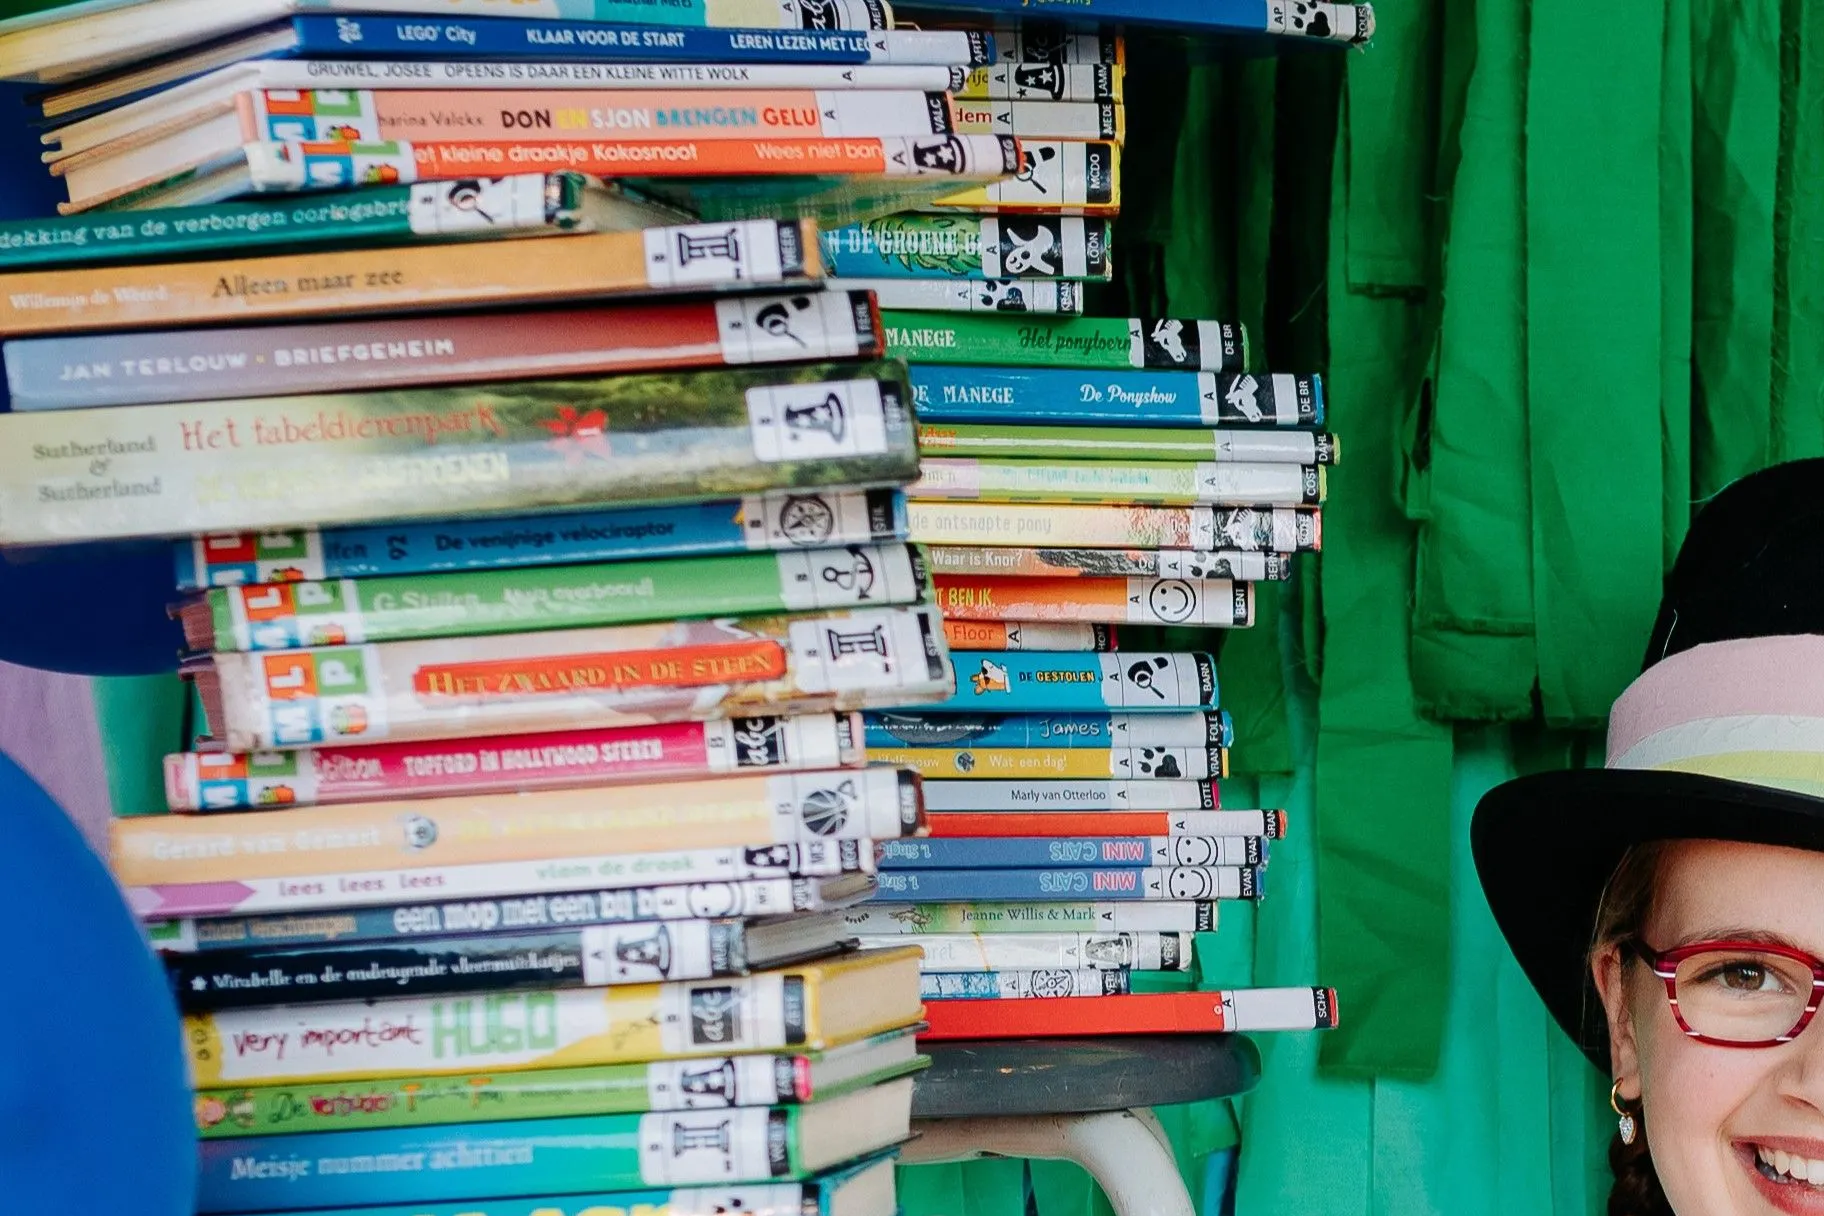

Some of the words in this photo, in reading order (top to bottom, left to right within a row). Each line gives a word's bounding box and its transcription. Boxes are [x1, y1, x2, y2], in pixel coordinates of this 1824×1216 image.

[445, 26, 476, 45] City
[526, 27, 574, 45] KLAAR
[578, 28, 618, 46] VOOR
[621, 30, 641, 46] DE
[643, 31, 685, 47] START
[729, 34, 773, 49] LEREN
[776, 35, 817, 51] LEZEN
[819, 36, 846, 51] MET
[382, 62, 432, 79] JOSEE
[444, 65, 505, 80] OPEENS
[526, 66, 569, 81] DAAR
[573, 66, 601, 81] EEN
[605, 65, 656, 81] KLEINE
[659, 66, 704, 82] WITTE
[500, 110, 552, 129] DON
[591, 108, 650, 129] SJON
[656, 108, 758, 128] BRENGEN
[1100, 104, 1113, 135] MEDE
[440, 143, 504, 164] kleine
[508, 143, 589, 167] draakje
[593, 141, 698, 163] Kokosnoot
[1088, 153, 1101, 190] MCDO
[140, 218, 168, 238] de
[173, 210, 288, 236] verborgen
[884, 329, 957, 349] MANEGE
[1017, 324, 1053, 351] Het
[59, 359, 111, 381] JAN
[119, 352, 248, 378] TERLOUW
[273, 339, 455, 369] BRIEFGEHEIM
[943, 386, 1015, 404] MANEGE
[1079, 383, 1102, 402] De
[1108, 384, 1177, 407] Ponyshow
[31, 434, 157, 462] Sutherland
[178, 418, 241, 453] Het
[1318, 433, 1328, 463] DAHL
[36, 476, 163, 503] Sutherland
[1306, 467, 1317, 497] COST
[435, 533, 464, 553] De
[560, 520, 676, 544] velociraptor
[934, 514, 1011, 534] ontsnapte
[1016, 516, 1052, 536] pony
[931, 548, 966, 567] Waar
[968, 550, 983, 567] is
[985, 551, 1024, 569] Knor?
[948, 588, 974, 608] BEN
[1235, 587, 1246, 618] BENT
[953, 623, 995, 641] Floor
[1035, 670, 1095, 684] GESTOLEN
[1202, 662, 1213, 694] BARN
[1039, 719, 1100, 738] James
[501, 744, 599, 772] HOLLYWOOD
[988, 754, 1015, 769] Wat
[1017, 756, 1041, 769] een
[1043, 753, 1069, 772] dag!
[1010, 788, 1041, 803] Marly
[1042, 790, 1061, 801] van
[1062, 788, 1107, 801] Otterloo
[1049, 842, 1098, 862] CATS
[1101, 842, 1146, 861] MINI
[1039, 871, 1089, 891] CATS
[1092, 871, 1137, 891] MINI
[961, 907, 1004, 924] Jeanne
[1006, 906, 1044, 922] Willis
[1063, 905, 1097, 922] Mark
[234, 1030, 289, 1062] Very
[300, 1014, 424, 1057] important
[430, 990, 557, 1059] HUGO
[230, 1152, 310, 1182] Meisje
